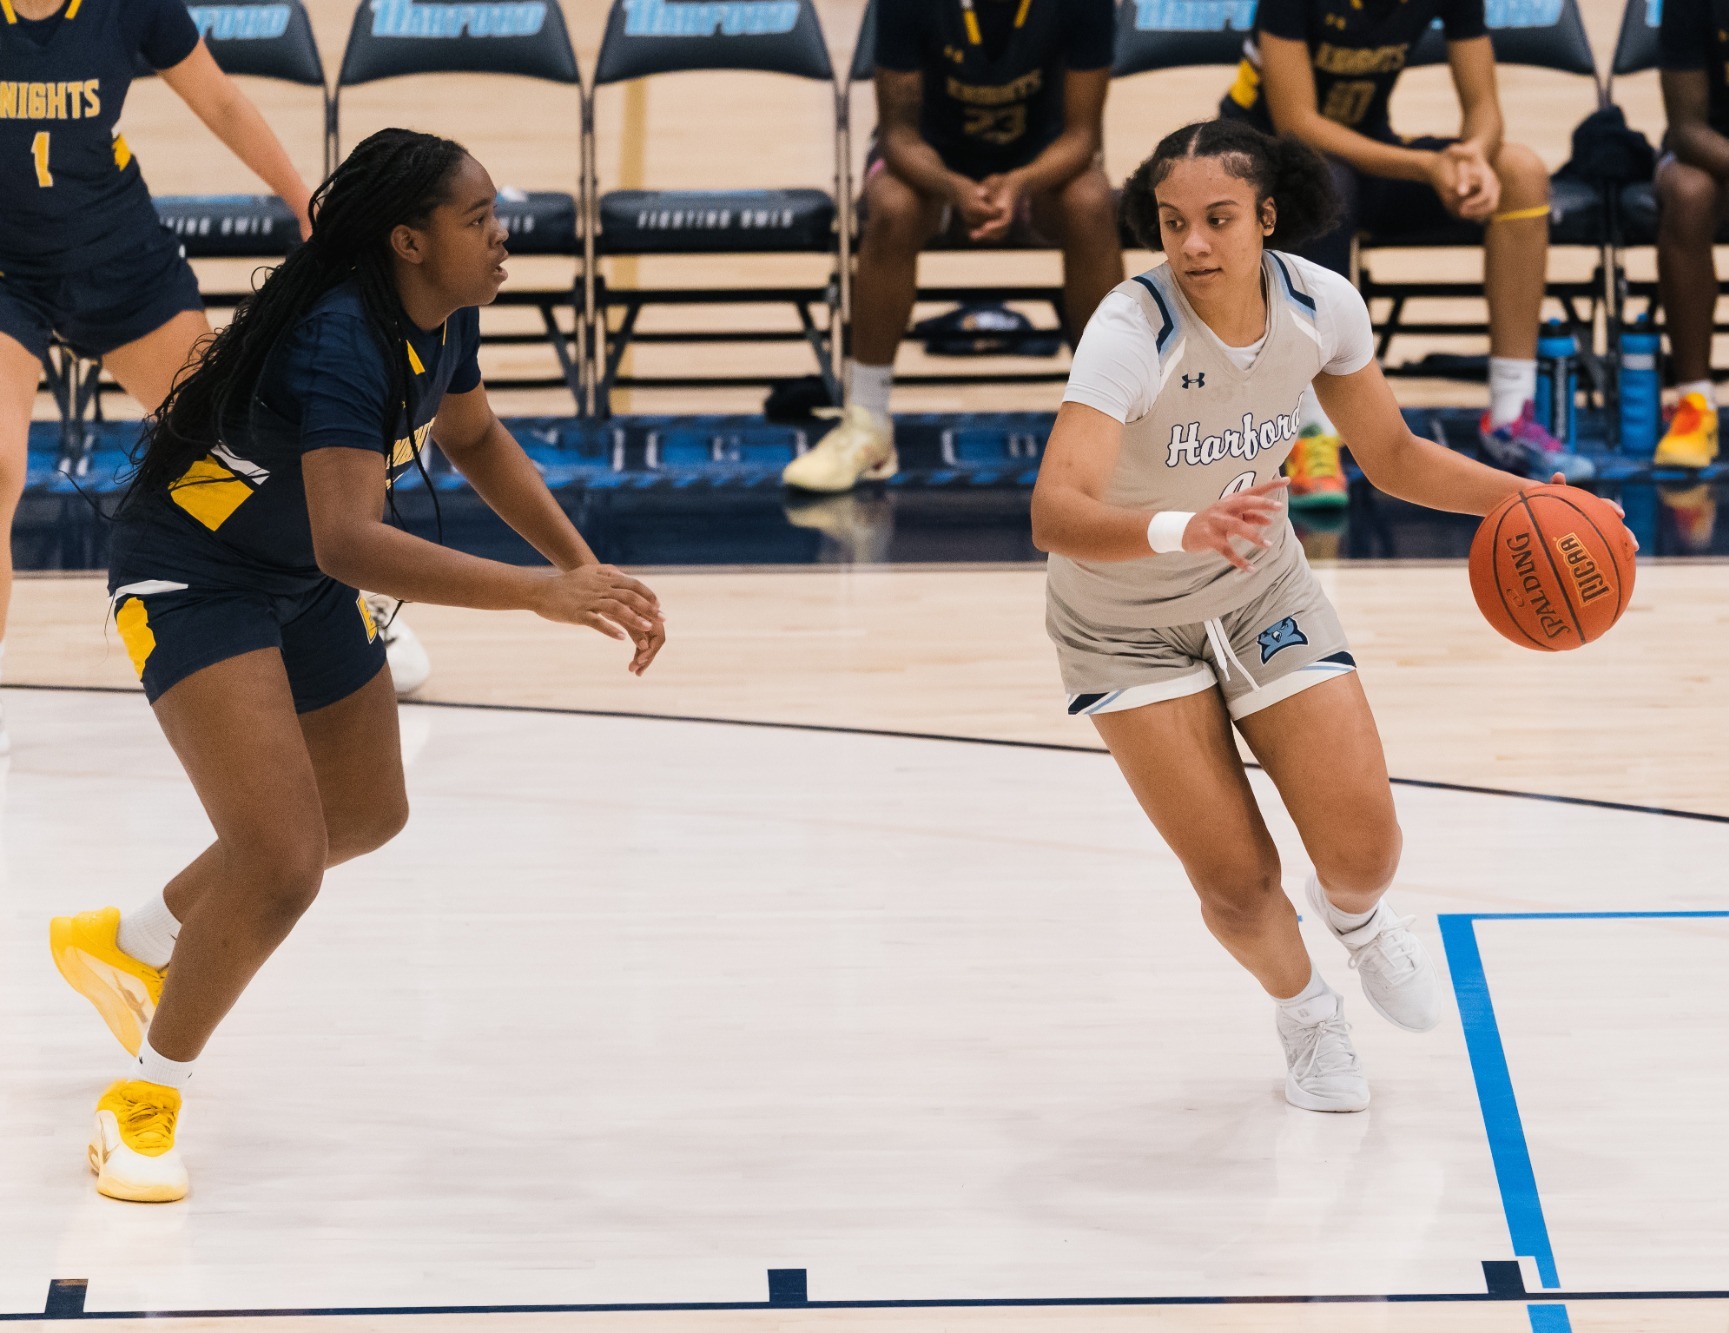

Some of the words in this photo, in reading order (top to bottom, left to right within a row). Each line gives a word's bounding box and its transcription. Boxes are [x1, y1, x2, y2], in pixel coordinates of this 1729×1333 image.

[0, 79, 100, 119] NIGHTS
[31, 131, 53, 187] 1
[1165, 391, 1304, 467] Harford
[1506, 532, 1571, 638] SPALDING
[1559, 535, 1611, 604] NJCAA
